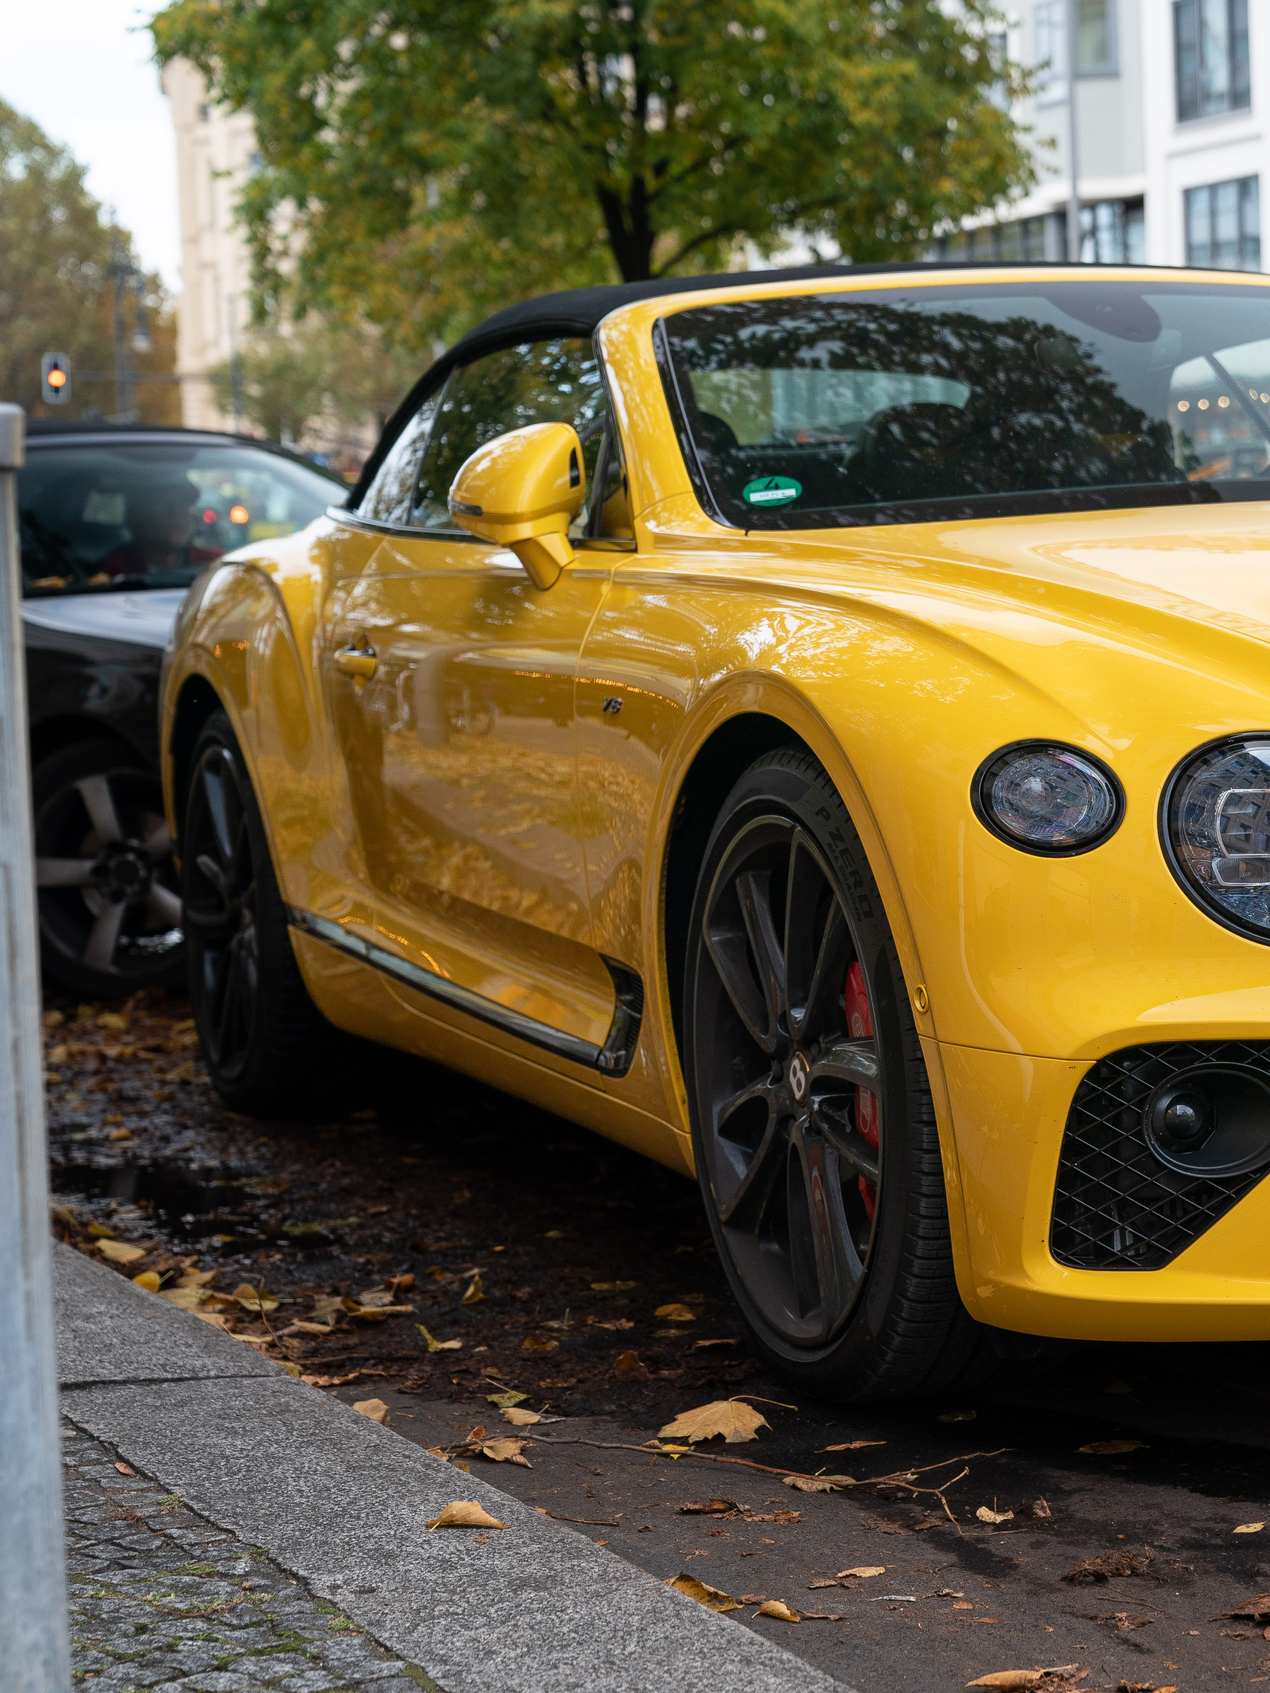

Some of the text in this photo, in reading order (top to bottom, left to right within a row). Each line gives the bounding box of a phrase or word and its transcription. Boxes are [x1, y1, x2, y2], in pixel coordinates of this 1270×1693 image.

[764, 478, 780, 490] 4
[815, 806, 874, 919] P ZERO
[789, 1059, 806, 1099] B
